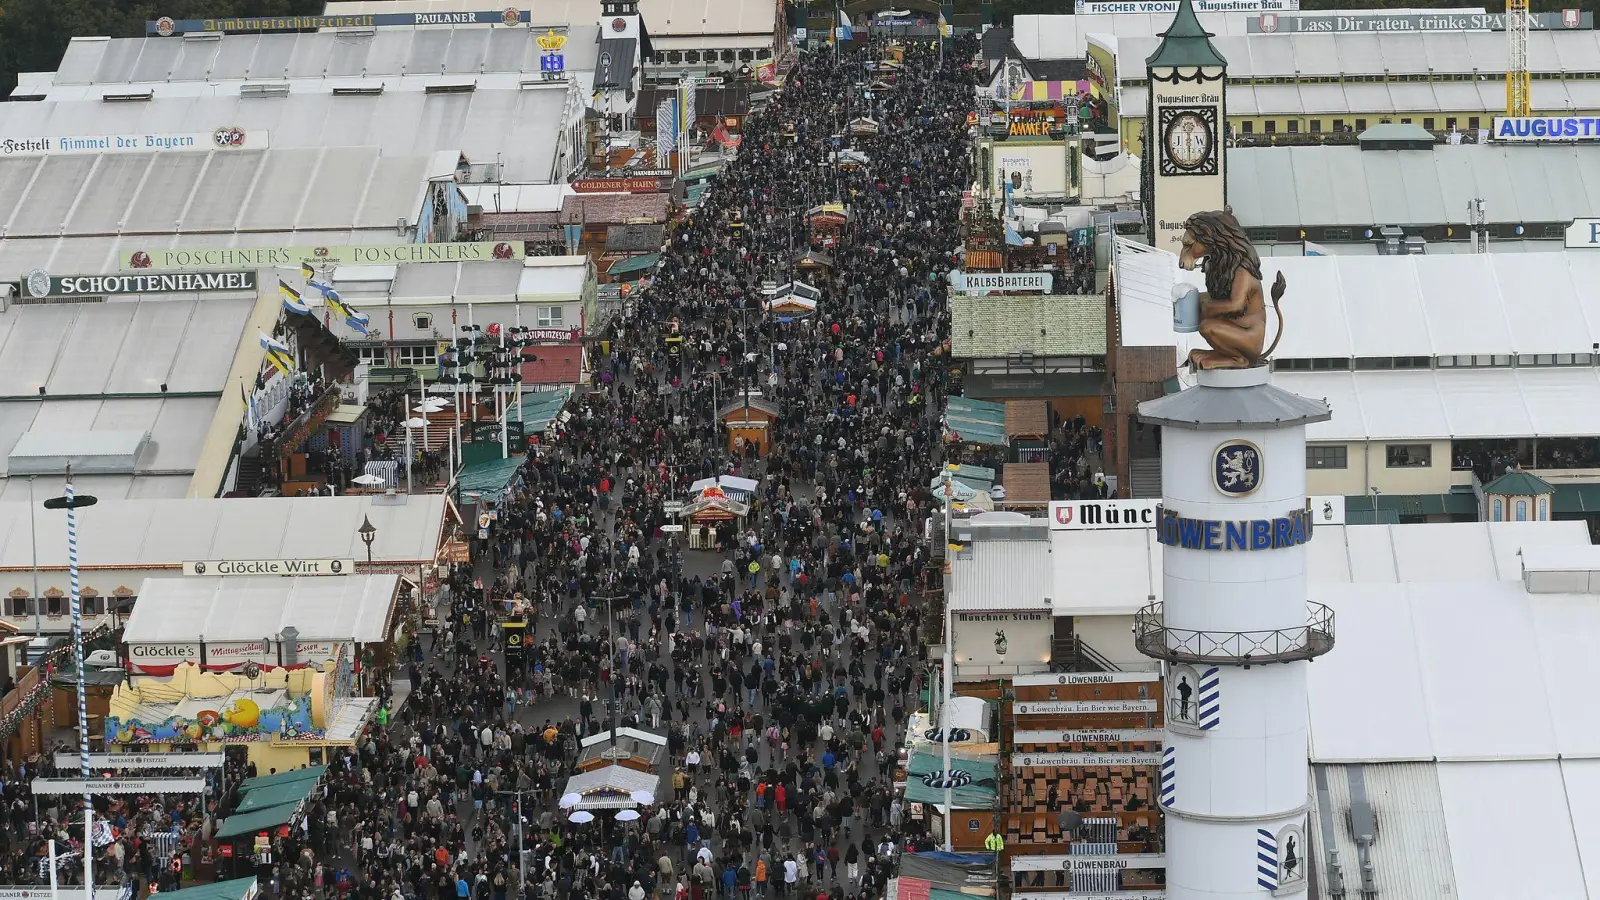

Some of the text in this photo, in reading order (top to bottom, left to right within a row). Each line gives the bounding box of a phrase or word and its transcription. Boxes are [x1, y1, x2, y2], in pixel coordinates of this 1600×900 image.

[1092, 4, 1136, 12] FISCHER
[1139, 3, 1176, 11] VRONI
[1199, 1, 1258, 12] Augustiner
[1261, 0, 1283, 9] Bräu
[203, 15, 374, 31] Armbrustschützenzelt
[415, 12, 476, 24] PAULANER
[1296, 17, 1333, 32] Lass
[1337, 17, 1364, 31] Dir
[1368, 17, 1415, 32] raten,
[1419, 15, 1467, 30] trinke
[1009, 122, 1050, 136] AMMER
[60, 137, 110, 151] Himmel
[116, 135, 138, 149] der
[145, 134, 194, 150] Bayern
[581, 180, 654, 189] GOLDENER HAHN
[165, 247, 291, 266] POSCHNER'S
[354, 243, 481, 262] POSCHNER'S
[61, 272, 252, 294] SCHOTTENHAMEL
[475, 424, 520, 434] SCHOTTENAMEL
[1080, 504, 1153, 525] Münc
[1156, 500, 1314, 551] LÖWENBRÄU
[217, 560, 319, 574] Glöckle Wirt
[133, 644, 194, 657] Glöckle's
[1068, 675, 1113, 684] LÖWENBRÄU
[1072, 732, 1121, 743] LÖWENBRÄU
[1074, 860, 1128, 870] LÖWENBRÄU
